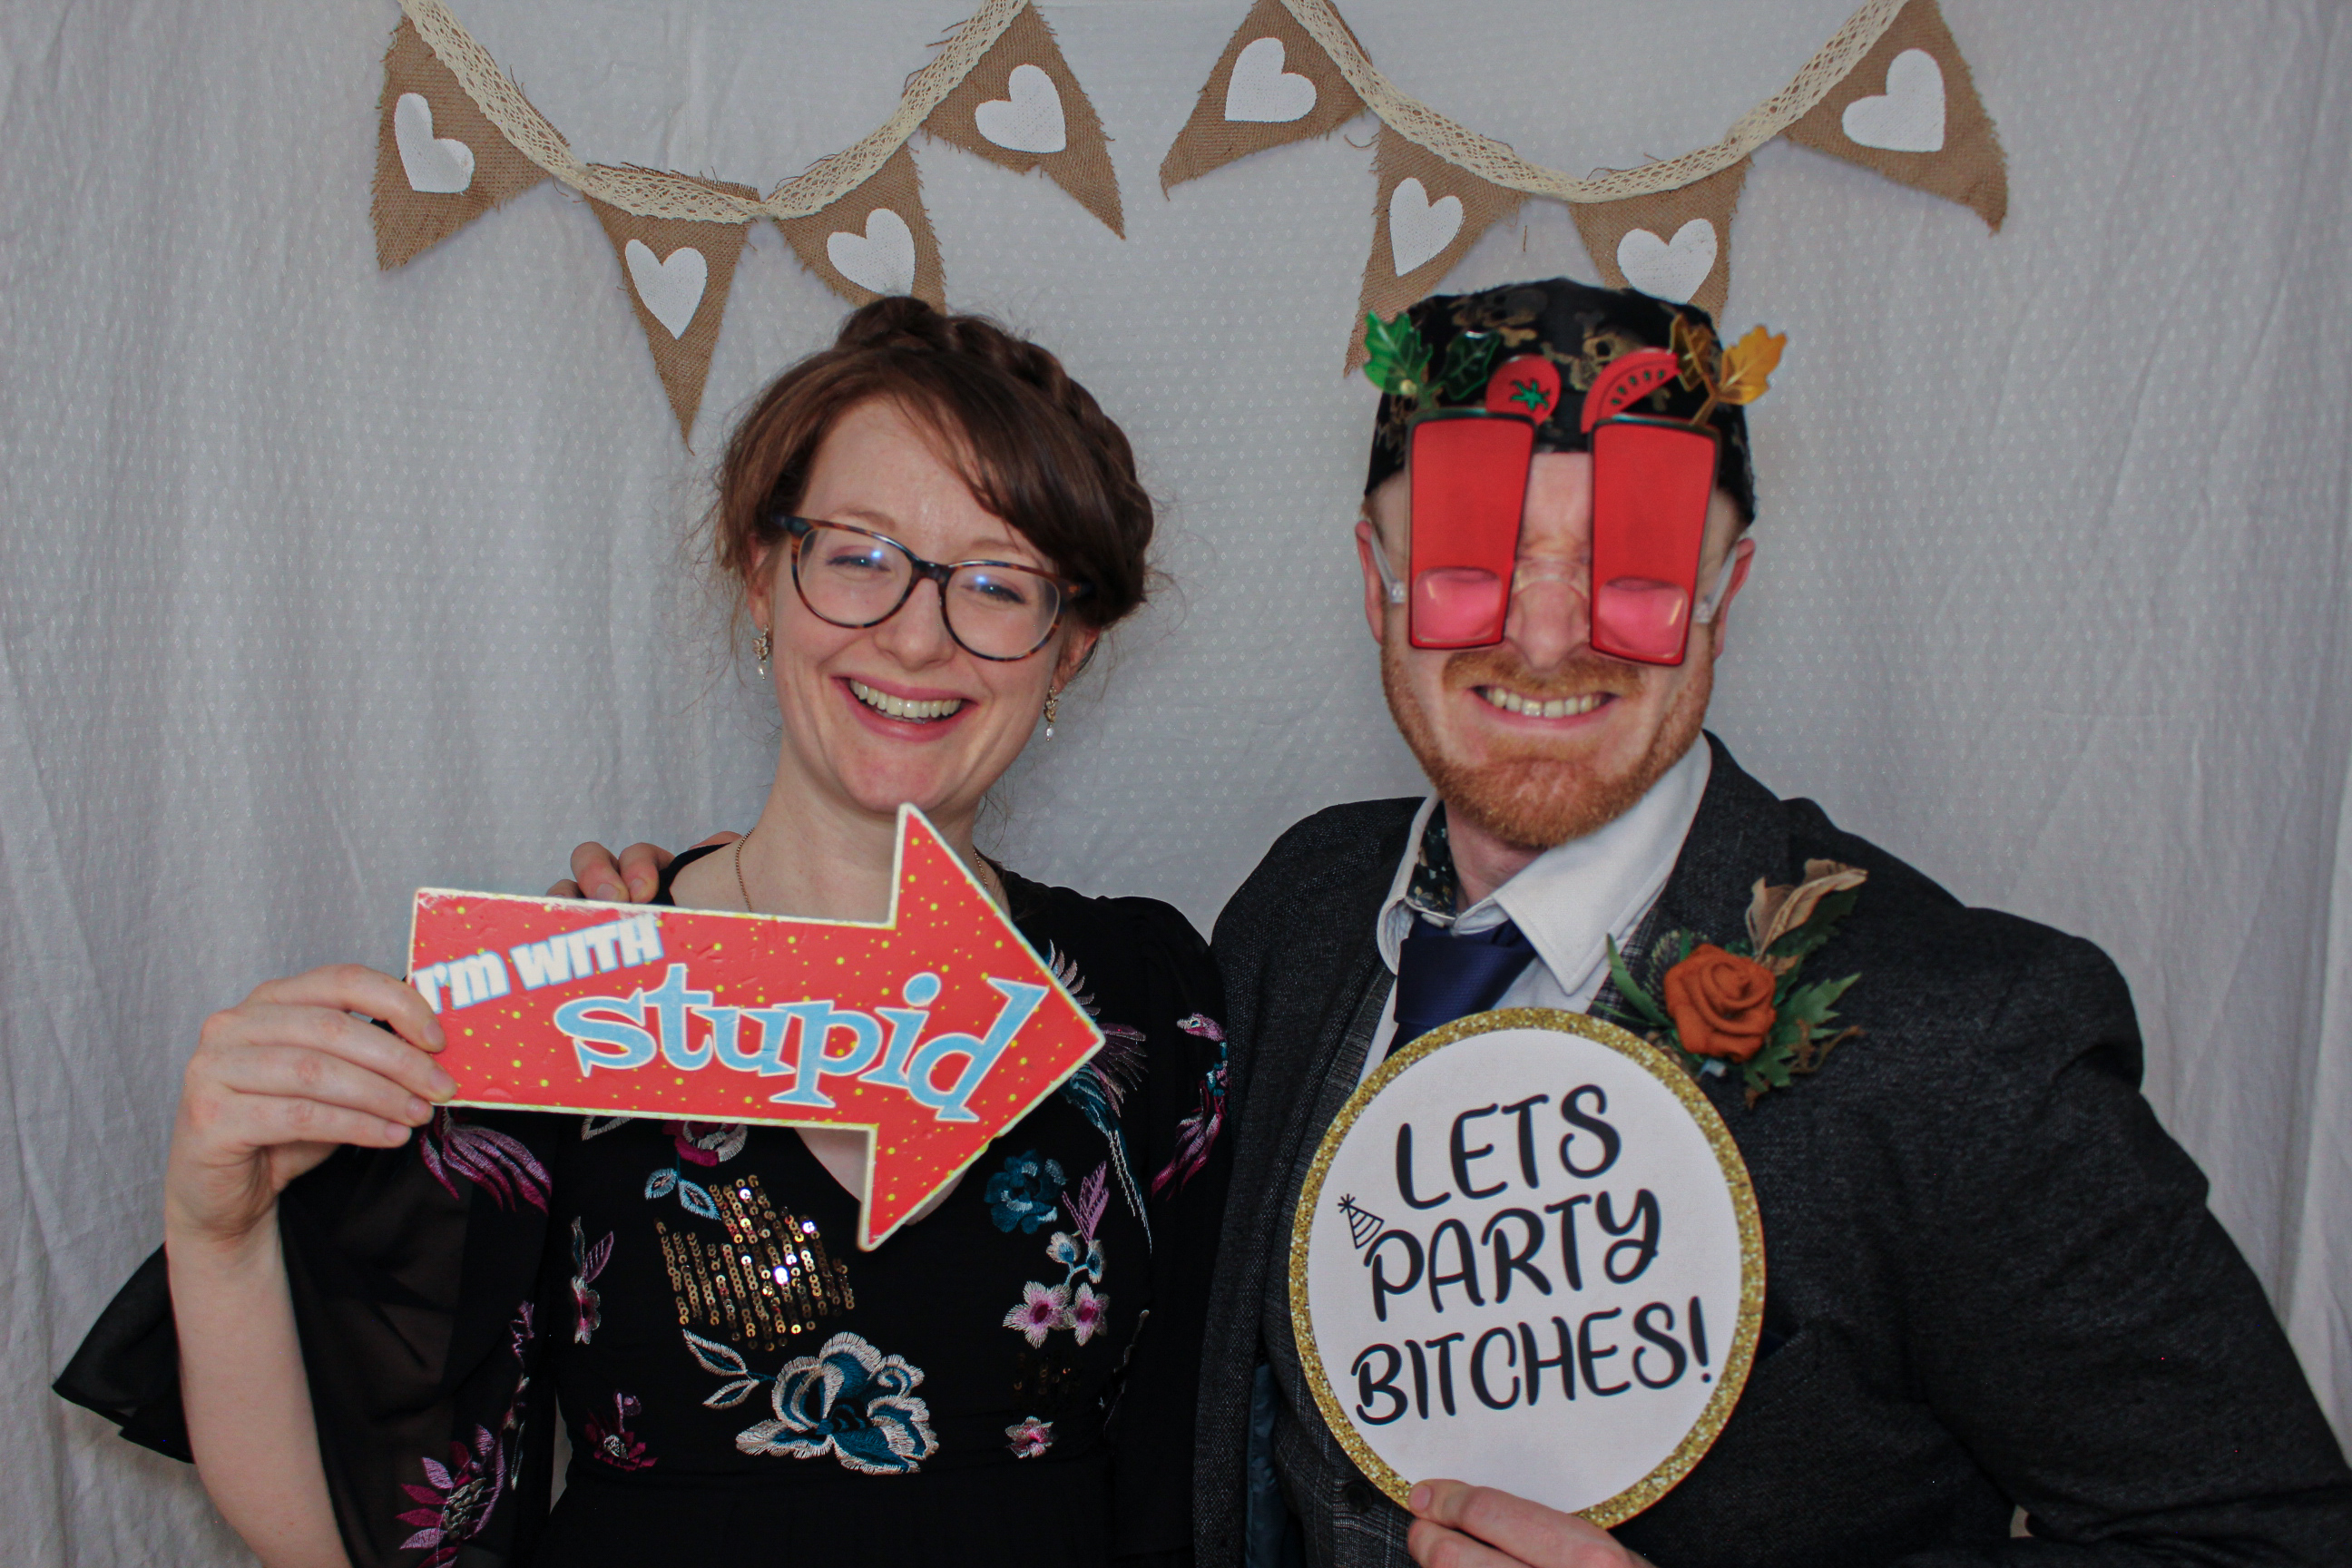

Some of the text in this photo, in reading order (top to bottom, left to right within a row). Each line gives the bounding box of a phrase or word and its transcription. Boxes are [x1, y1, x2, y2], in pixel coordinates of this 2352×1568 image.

[509, 912, 664, 990] WITH
[554, 963, 1049, 1121] stupid
[1396, 1083, 1622, 1210] LETS
[1363, 1189, 1661, 1322] PARTY
[1350, 1296, 1712, 1426] BITCHES!
